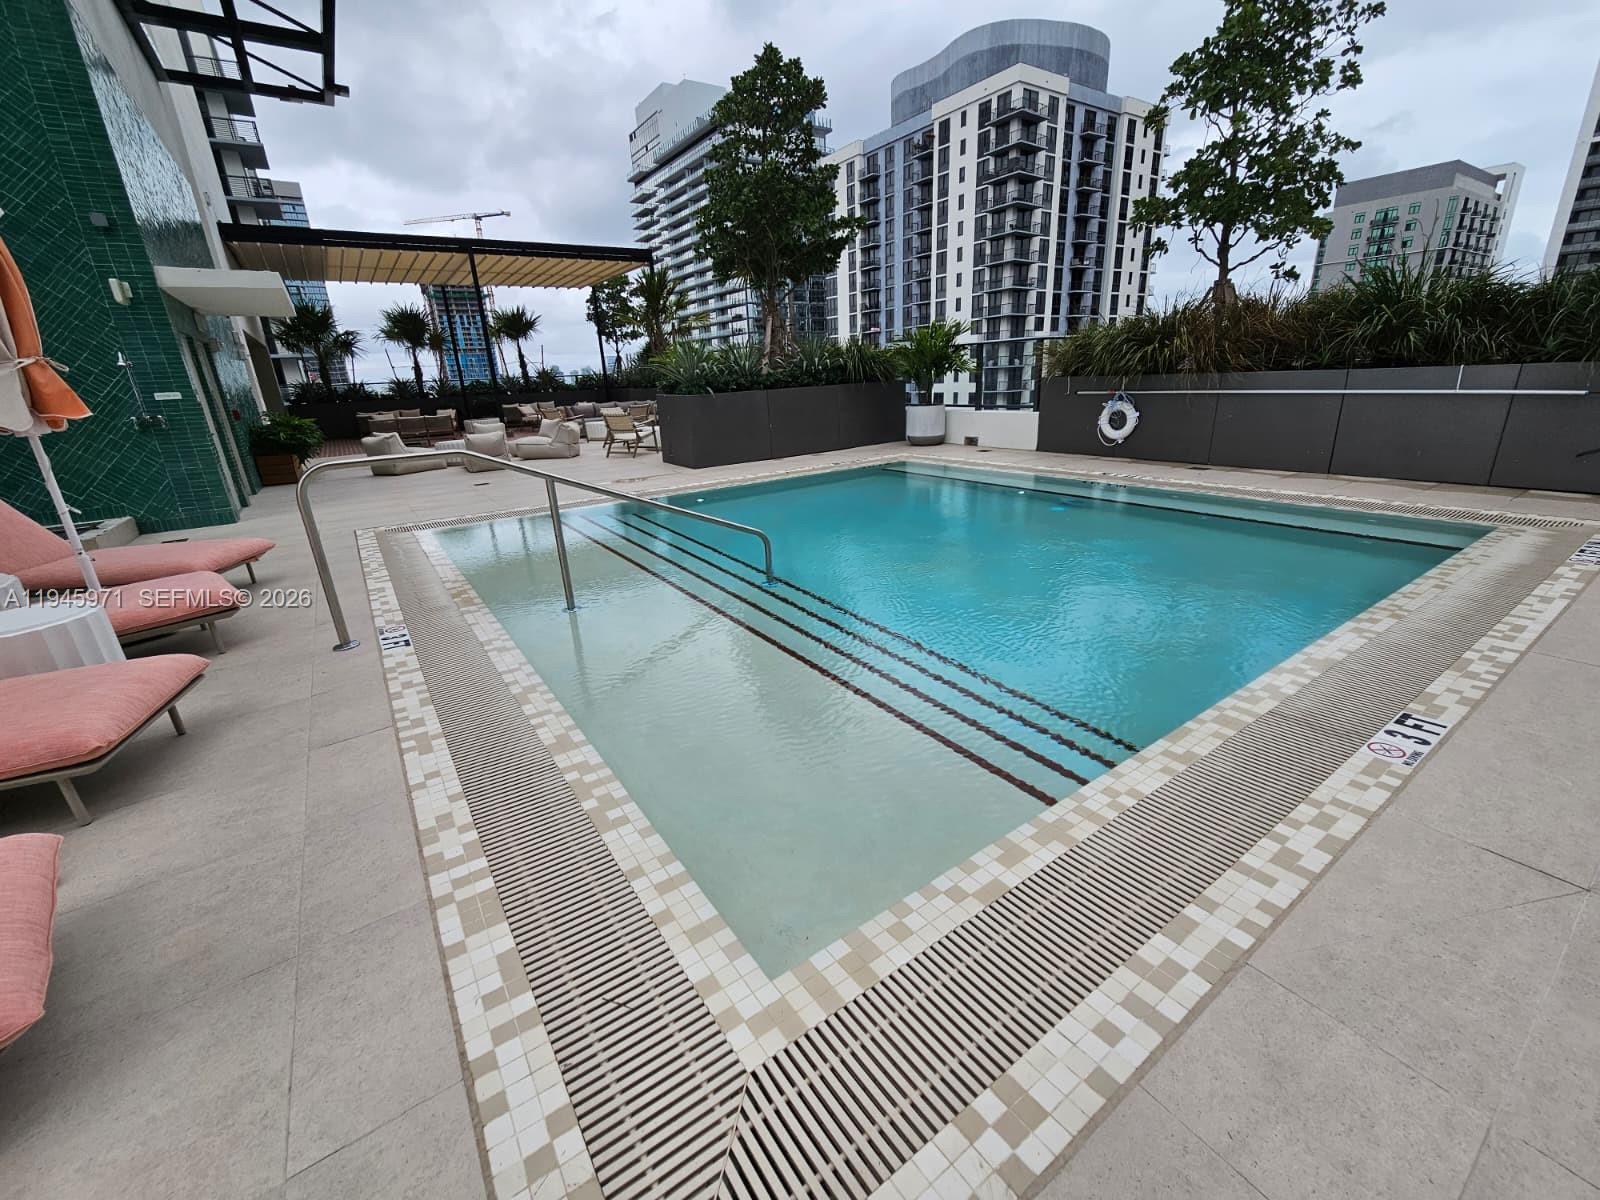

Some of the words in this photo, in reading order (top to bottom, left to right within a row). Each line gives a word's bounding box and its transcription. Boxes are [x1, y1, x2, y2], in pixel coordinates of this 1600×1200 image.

[382, 638, 411, 650] FT
[1393, 712, 1448, 736] FT
[1384, 729, 1432, 746] 3
